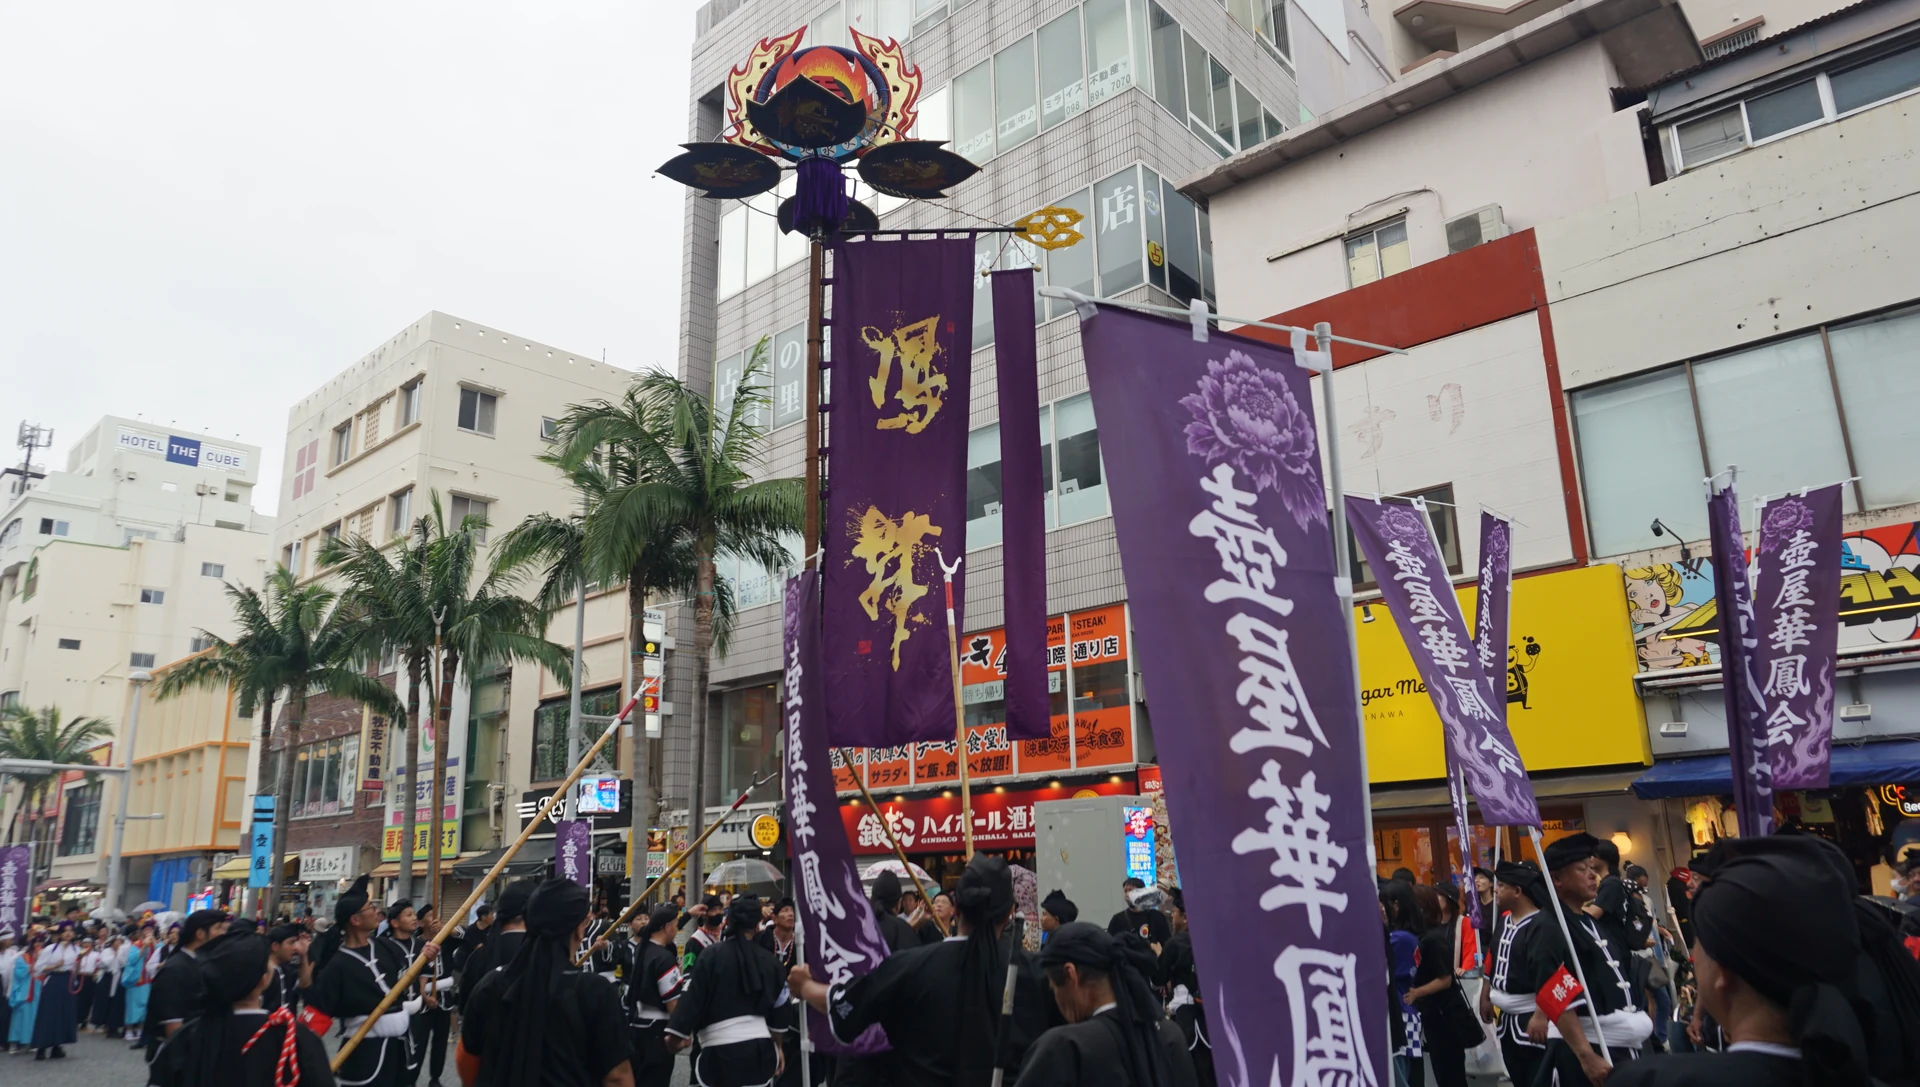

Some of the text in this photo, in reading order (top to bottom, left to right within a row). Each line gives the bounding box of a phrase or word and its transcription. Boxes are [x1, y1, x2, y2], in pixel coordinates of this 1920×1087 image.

[1066, 73, 1131, 115] 098 894 7070
[120, 434, 241, 467] HOTEL THE CUBE
[1476, 554, 1497, 693] 壺屋華
[1361, 687, 1394, 706] gar
[1364, 709, 1404, 720] INAWA
[857, 805, 917, 850] 銀だこ
[920, 831, 1036, 845] GINDACO GHBALL SAKA
[561, 838, 579, 881] 壺屋
